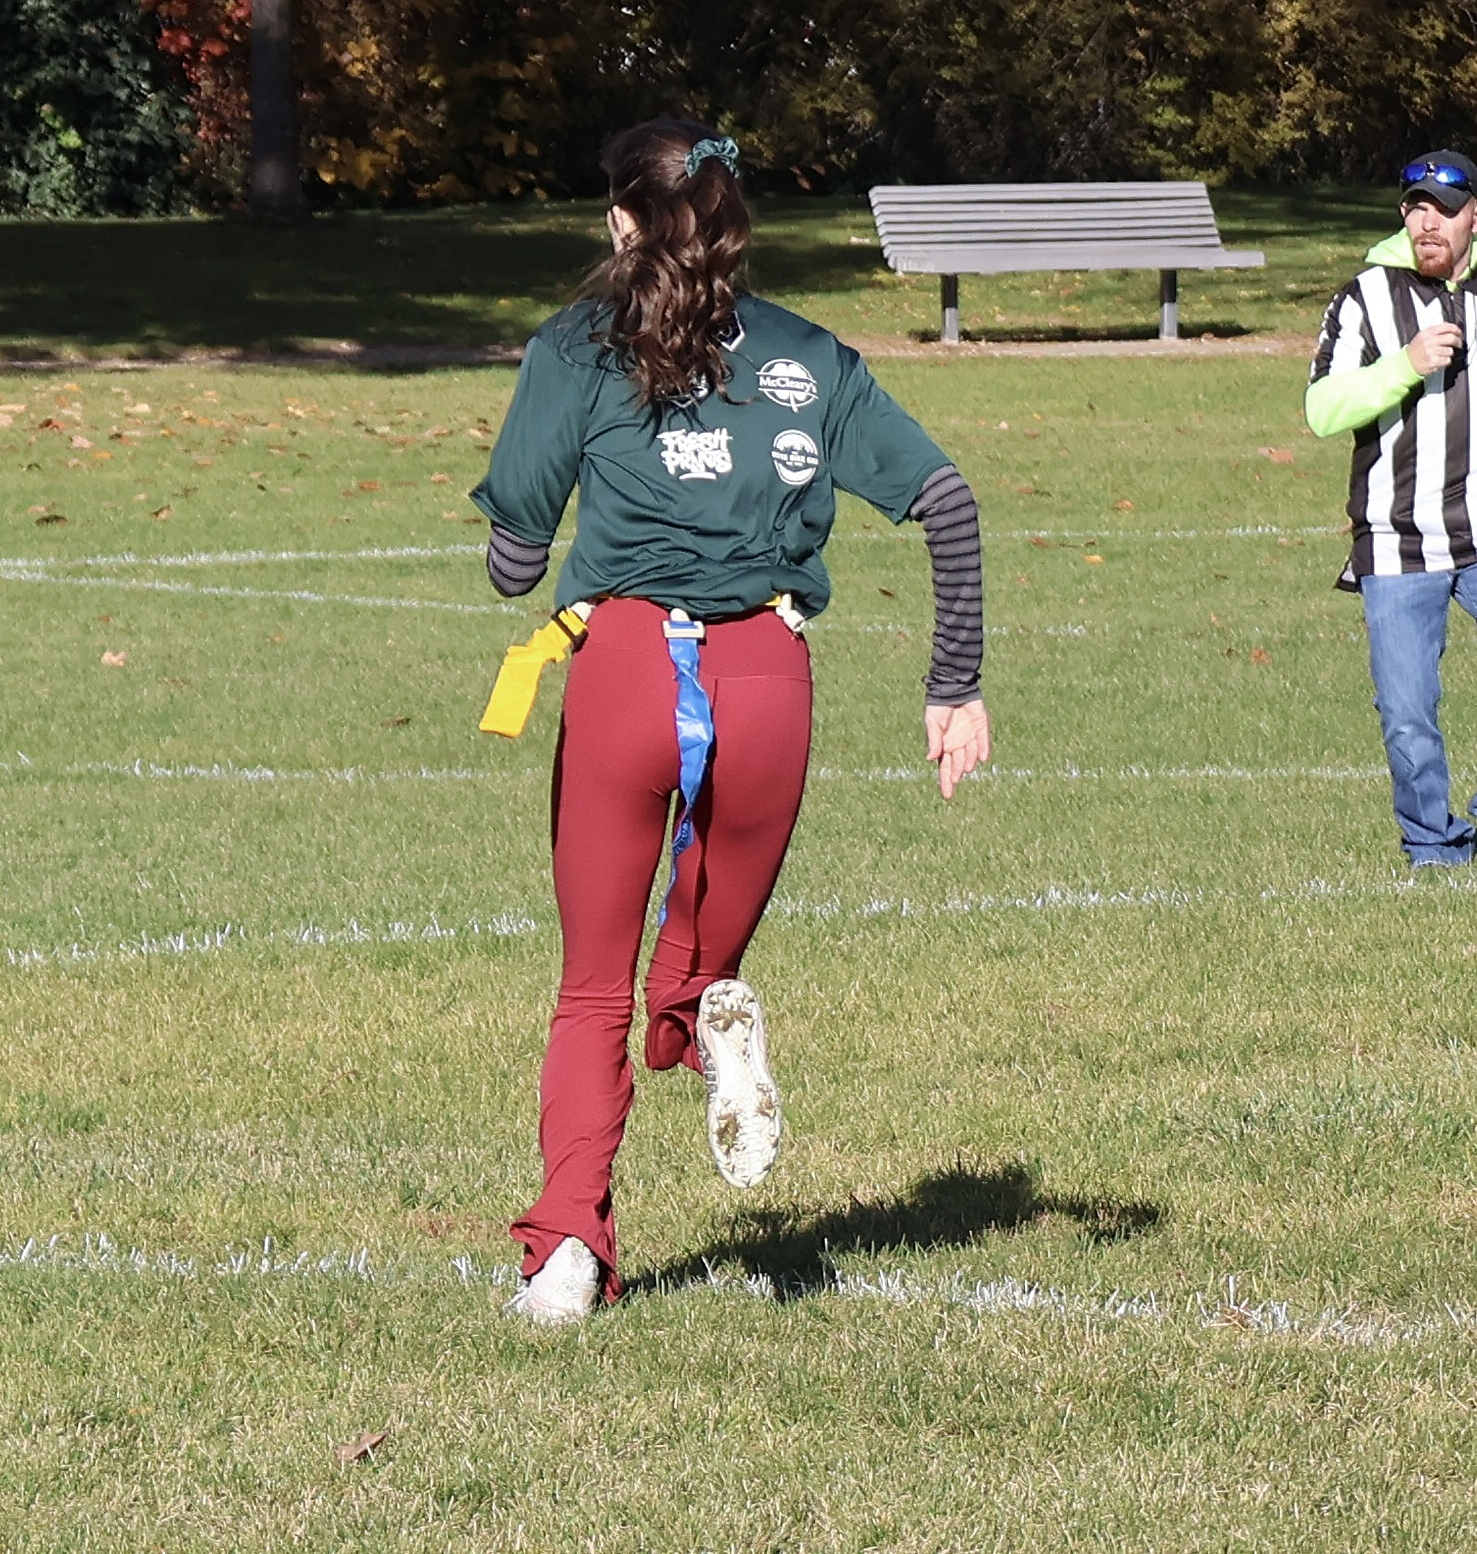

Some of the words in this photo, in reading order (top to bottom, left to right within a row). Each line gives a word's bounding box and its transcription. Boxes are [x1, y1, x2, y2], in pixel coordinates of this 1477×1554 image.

[759, 376, 817, 393] McCleary's
[656, 427, 734, 452] FRESH
[660, 449, 733, 475] PRINTS
